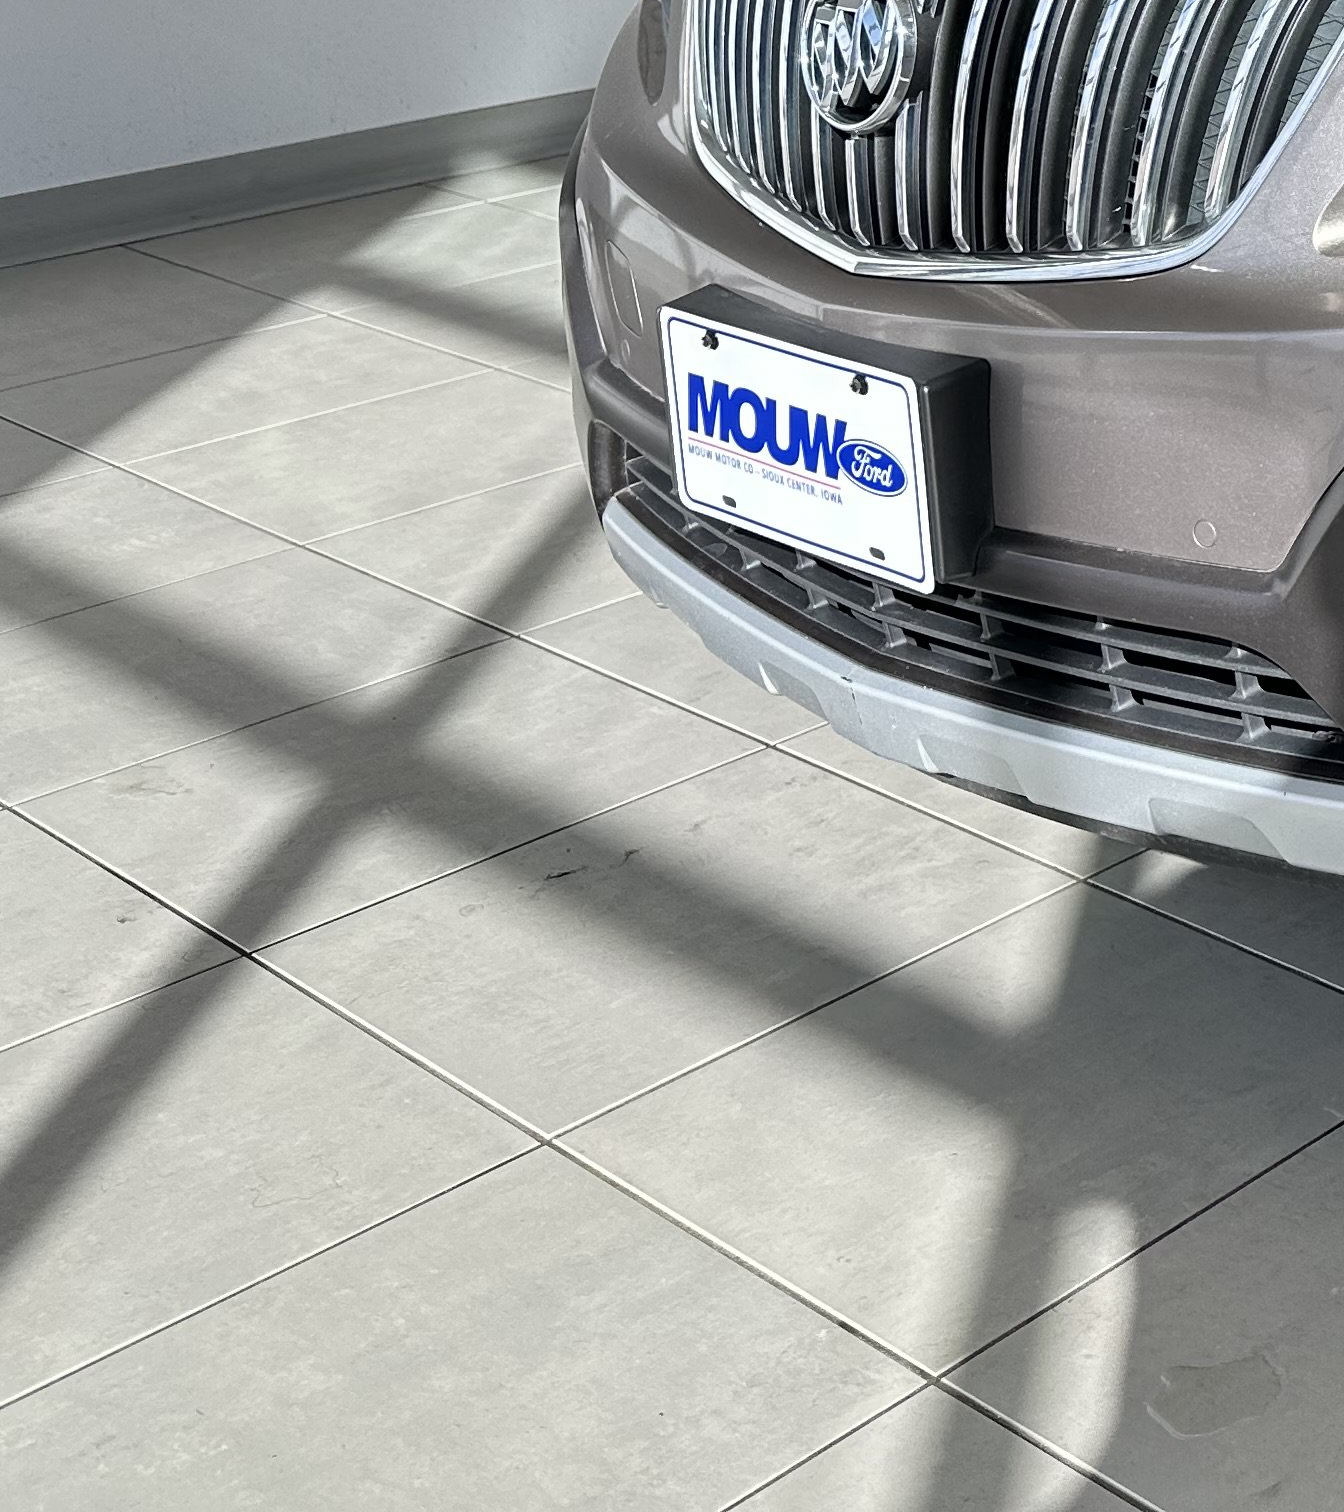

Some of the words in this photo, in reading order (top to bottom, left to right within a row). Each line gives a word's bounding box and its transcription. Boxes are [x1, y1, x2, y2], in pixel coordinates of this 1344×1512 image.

[687, 372, 847, 480] MOUW
[688, 443, 713, 460] MOUW
[714, 451, 742, 470] MOTOR
[743, 462, 754, 475] CO
[761, 468, 785, 486] SIOUX
[820, 489, 844, 506] IOWA
[850, 445, 894, 489] Ford
